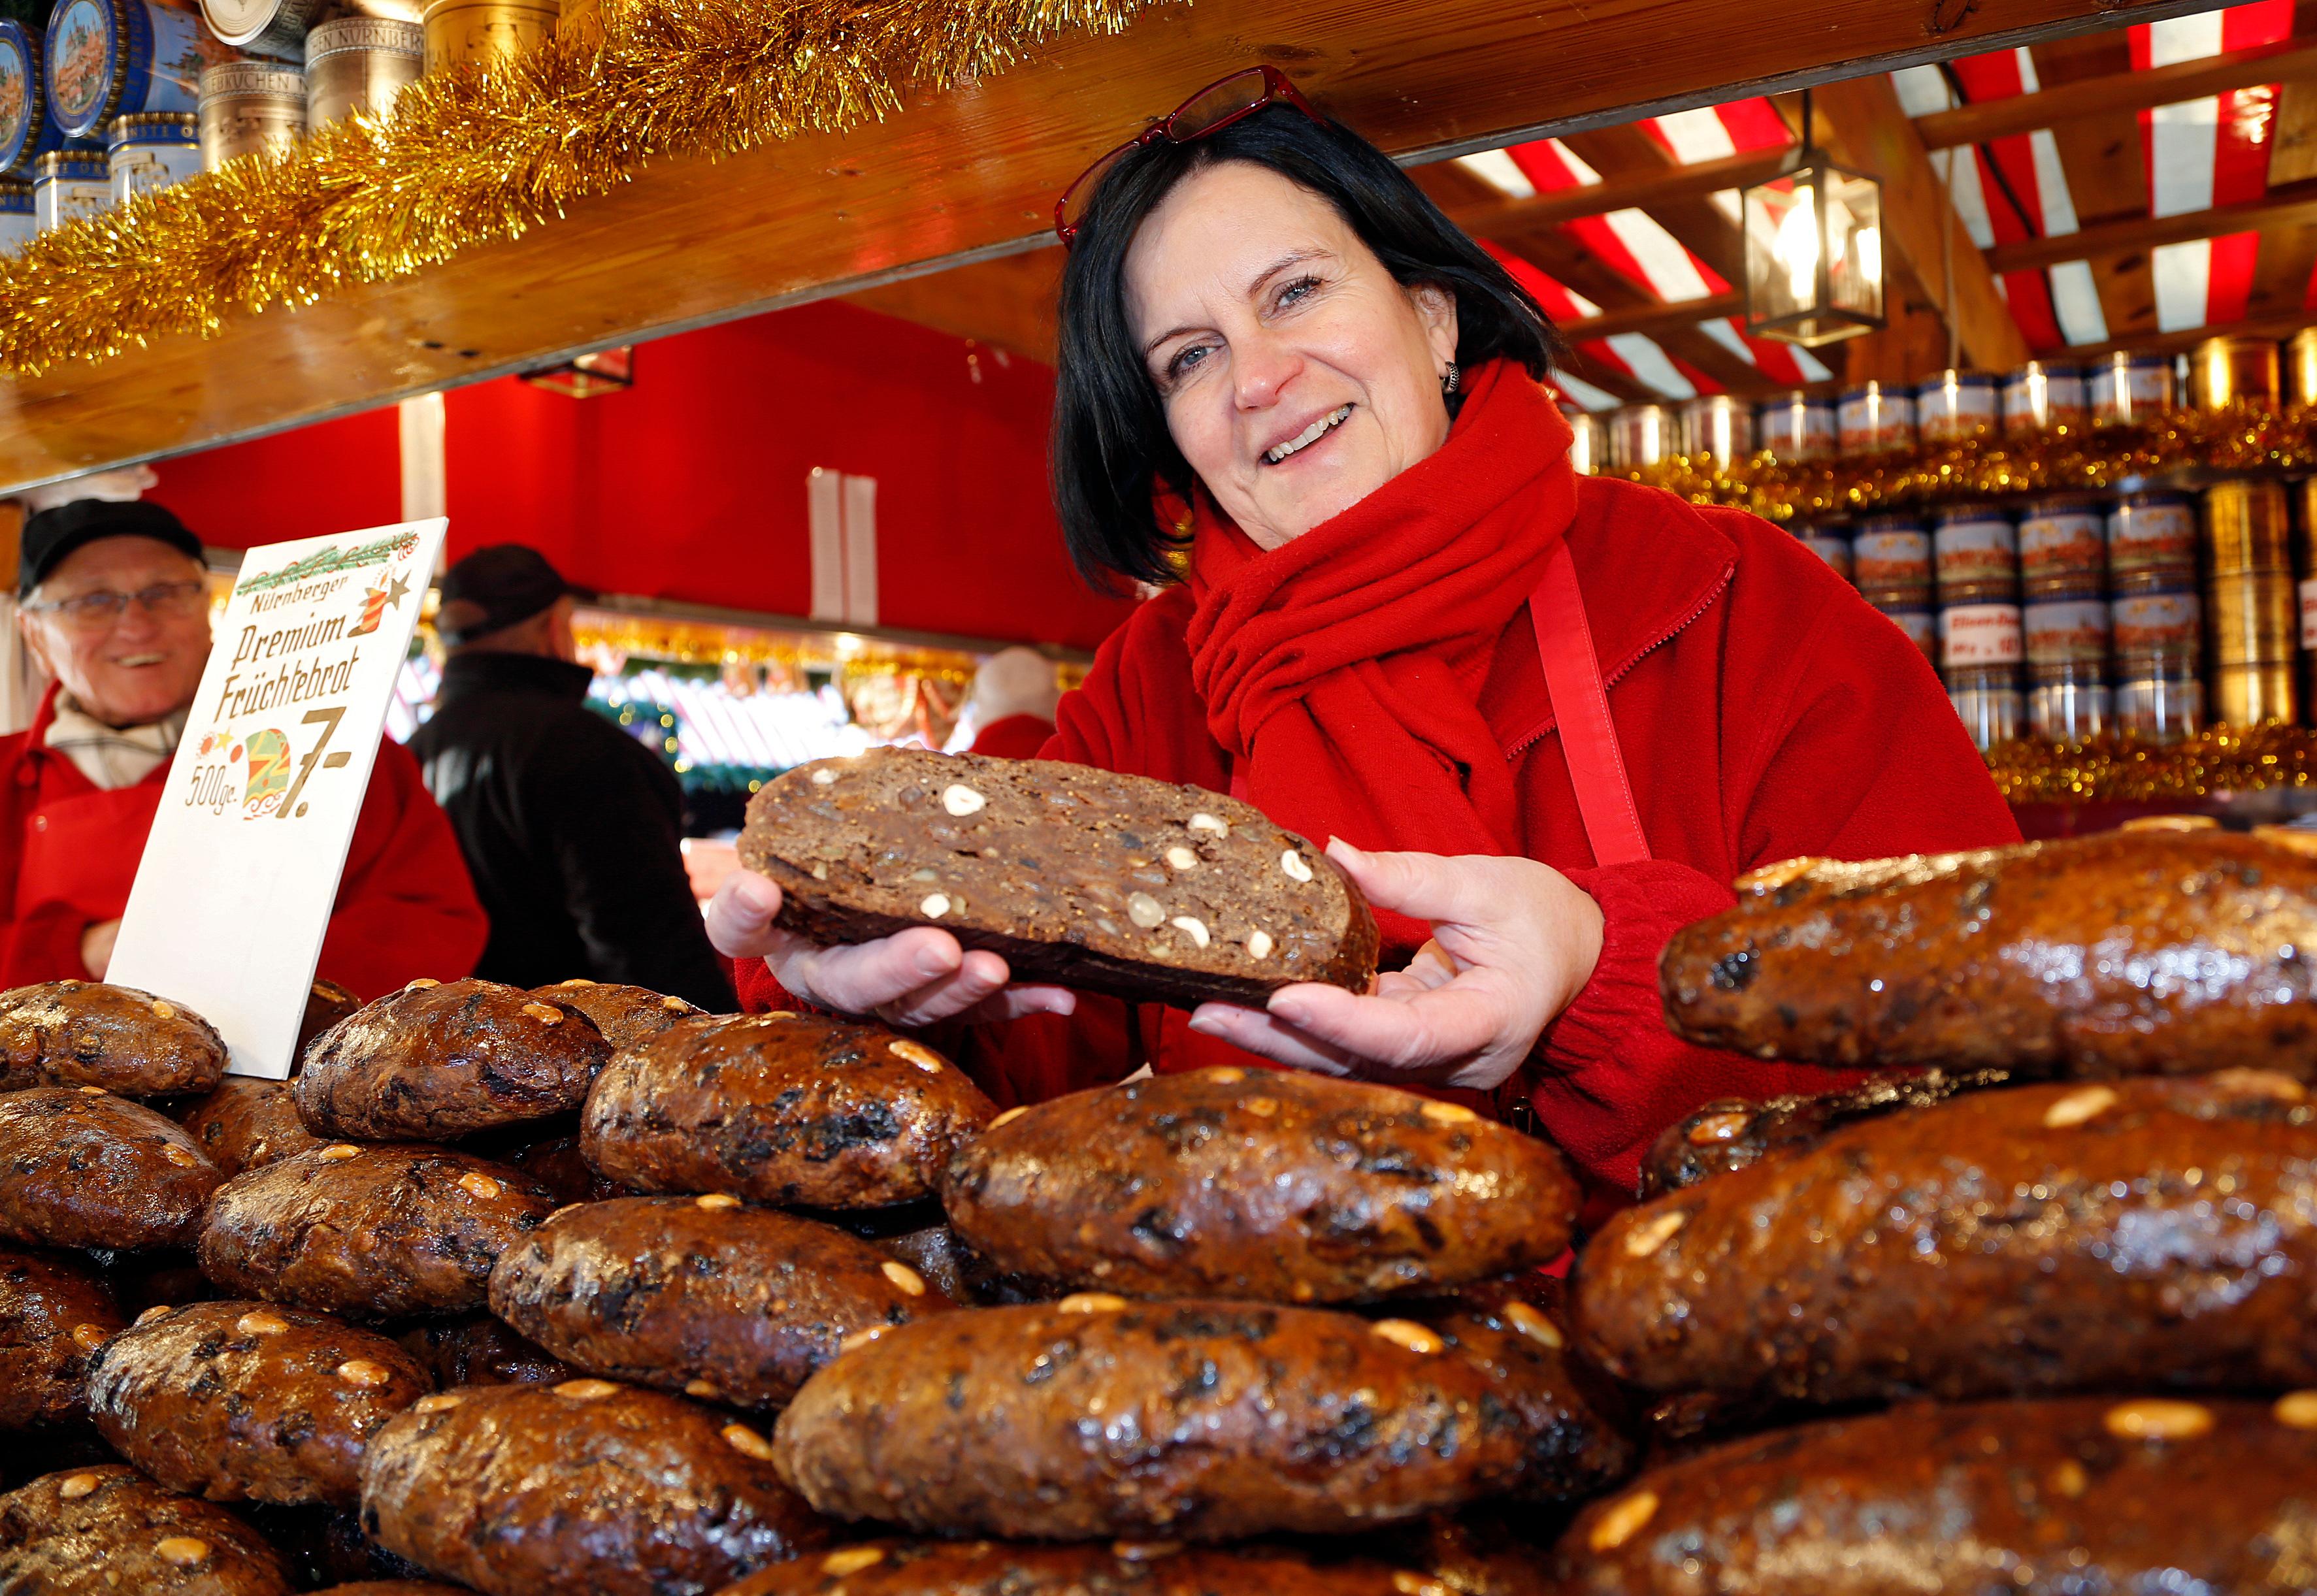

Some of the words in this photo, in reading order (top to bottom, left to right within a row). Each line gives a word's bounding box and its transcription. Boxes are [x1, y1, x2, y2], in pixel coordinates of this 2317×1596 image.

[250, 576, 348, 615] Nürnberger
[231, 611, 346, 672] Premium
[214, 645, 359, 724] Früchtebrot
